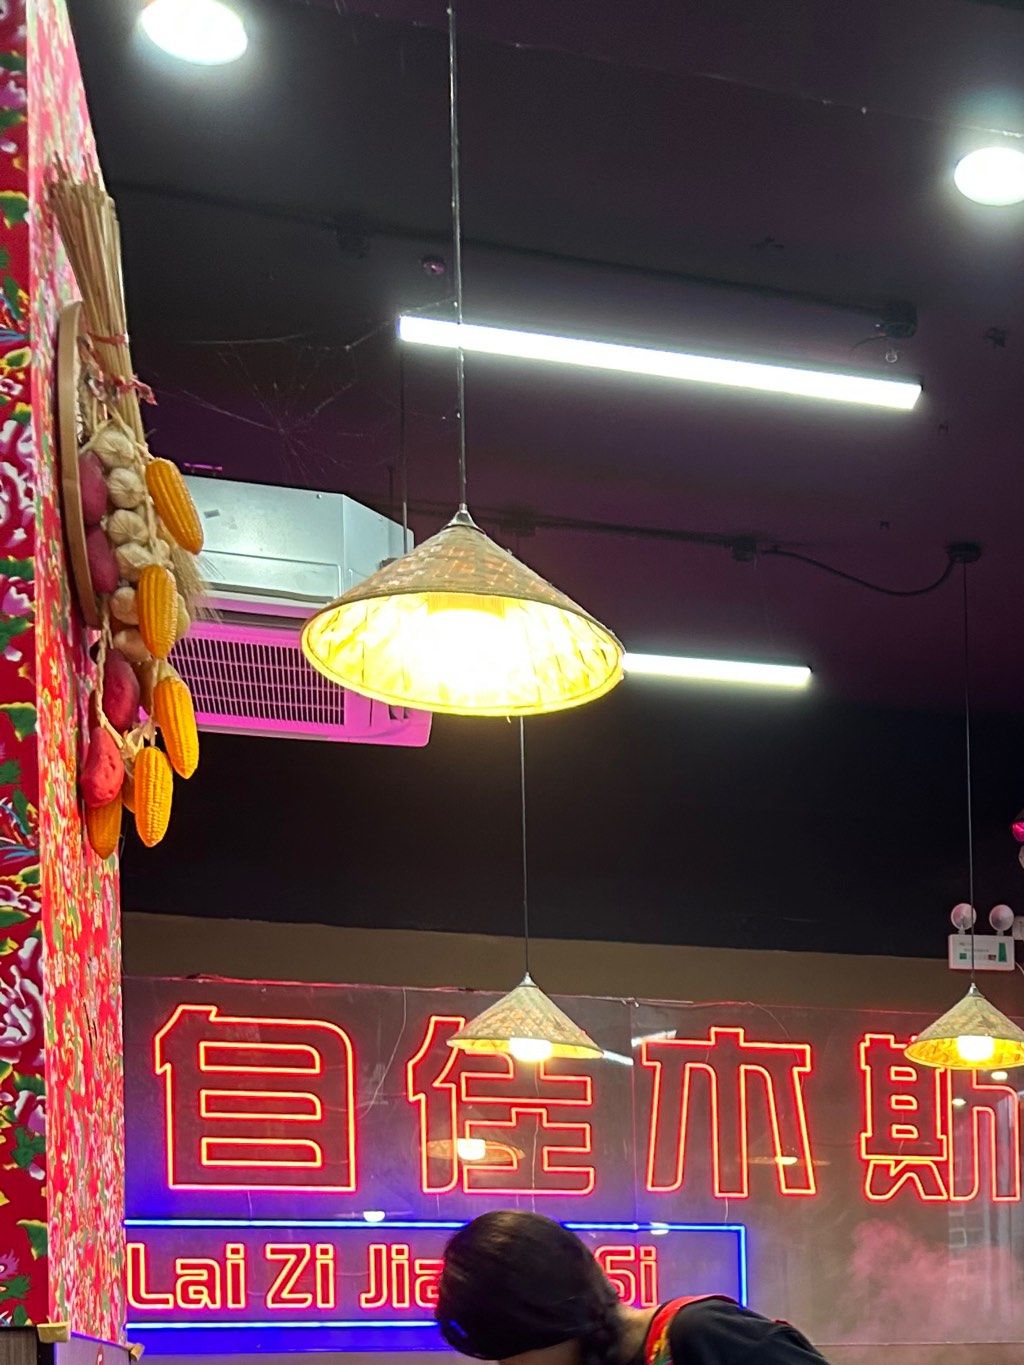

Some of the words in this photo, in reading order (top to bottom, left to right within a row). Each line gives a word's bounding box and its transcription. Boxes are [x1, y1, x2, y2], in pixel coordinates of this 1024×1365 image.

[155, 1004, 1021, 1201] 自佳木斯
[127, 1242, 247, 1310] Lai
[265, 1242, 336, 1309] Zi
